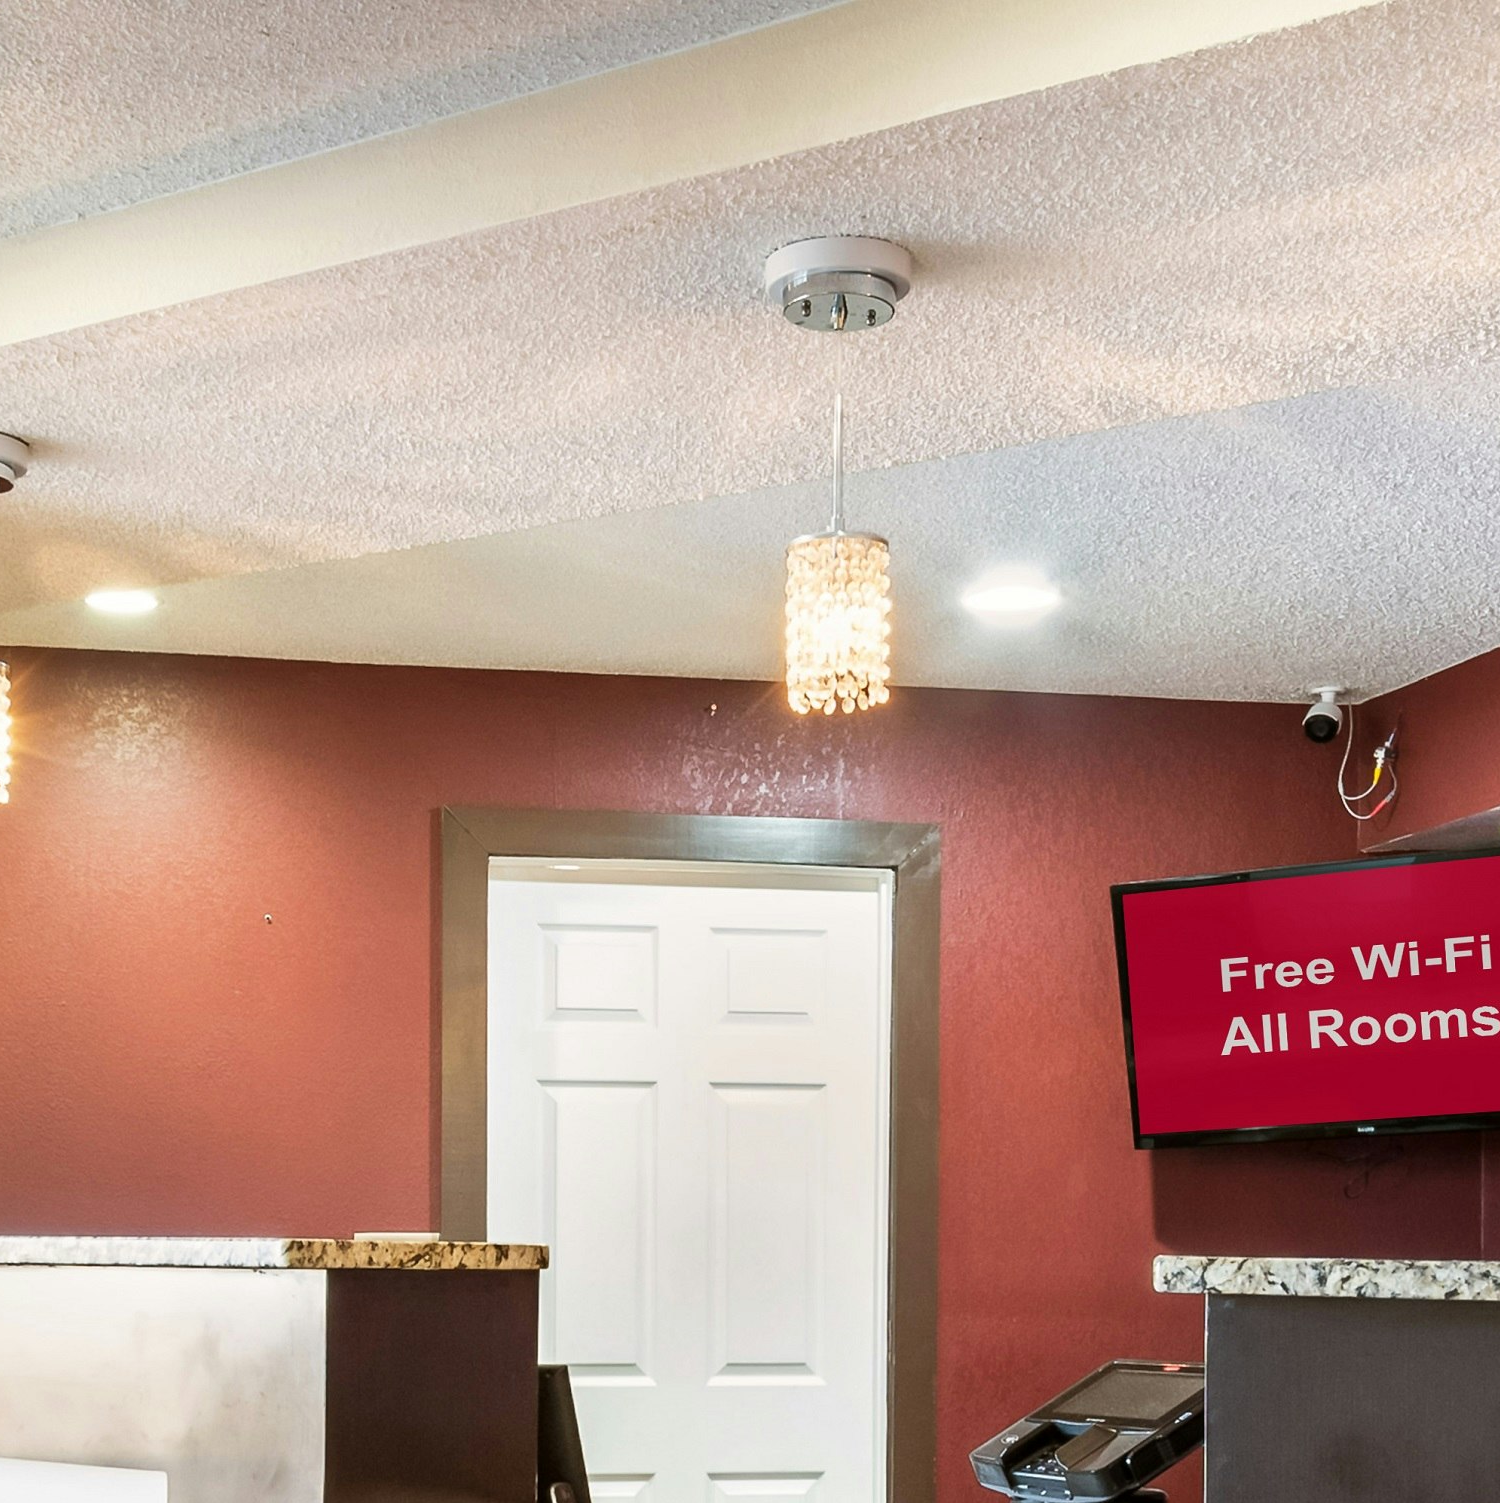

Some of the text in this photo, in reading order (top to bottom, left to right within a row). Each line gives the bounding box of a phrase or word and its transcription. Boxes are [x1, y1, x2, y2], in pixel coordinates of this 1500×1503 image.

[1220, 934, 1493, 993] Free Wi-Fi
[1220, 1012, 1290, 1056] All
